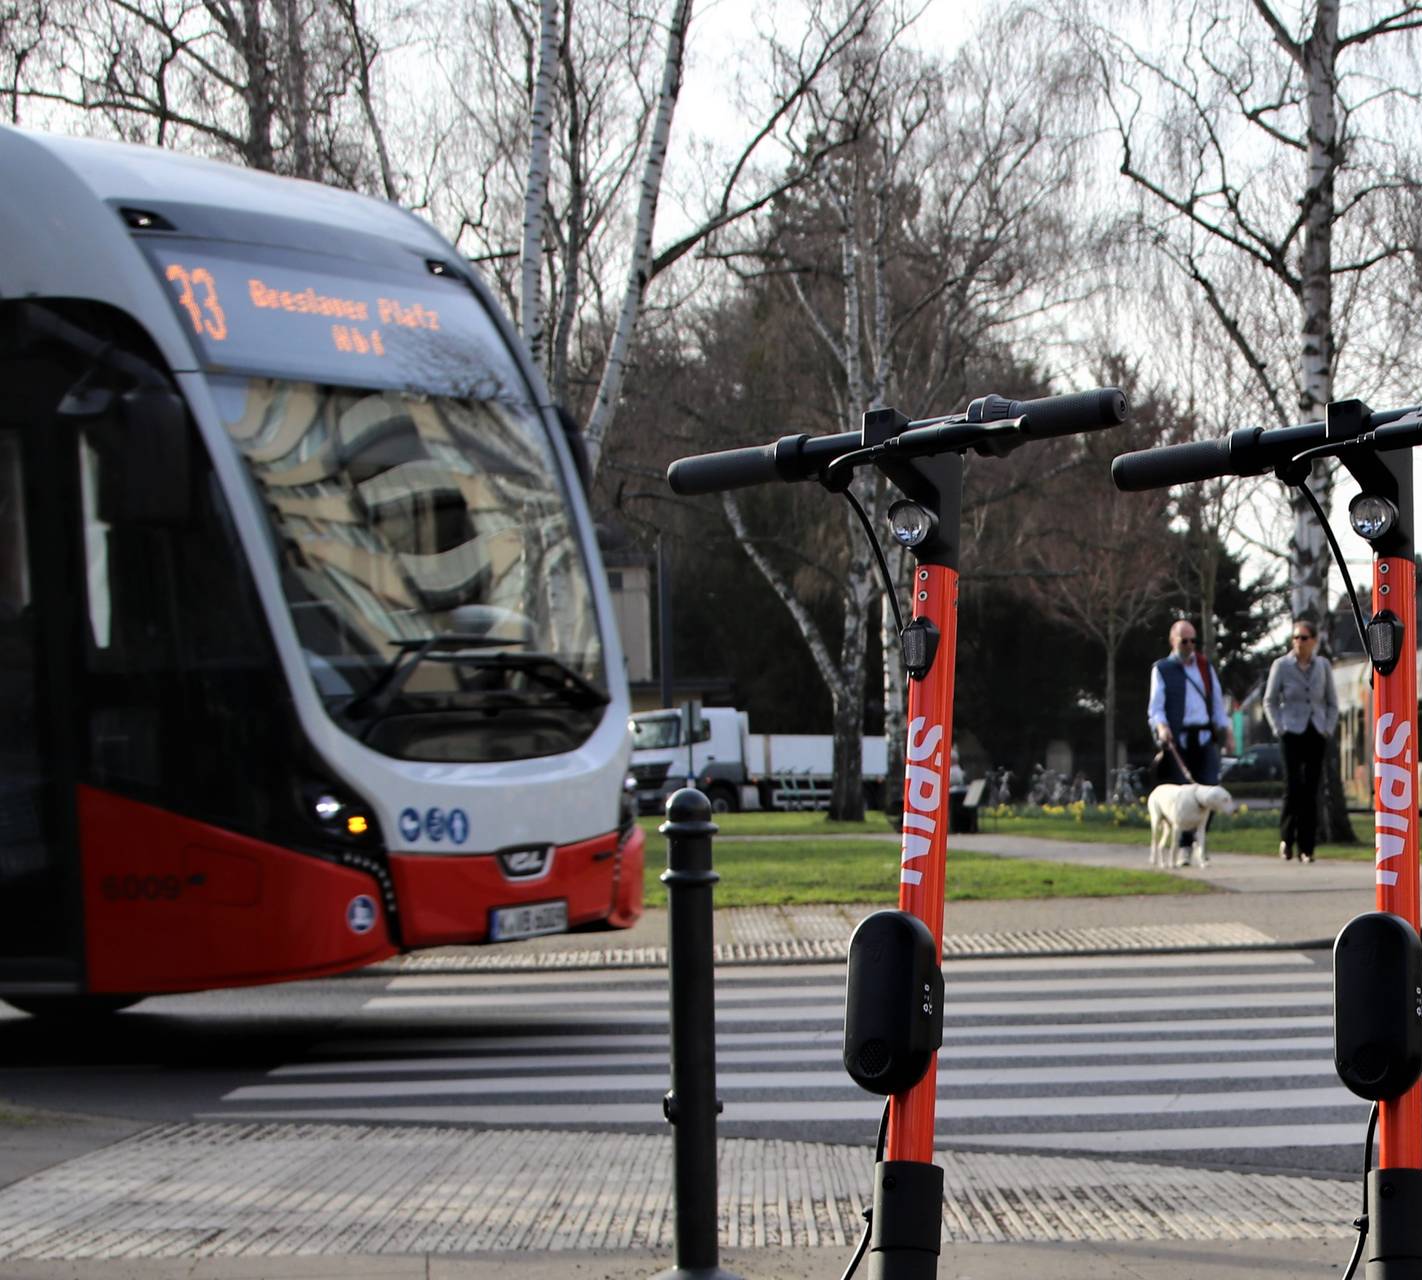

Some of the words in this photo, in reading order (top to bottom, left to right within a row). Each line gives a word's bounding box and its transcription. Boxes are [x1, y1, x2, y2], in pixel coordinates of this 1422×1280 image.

[249, 278, 368, 321] Breslauer
[377, 297, 440, 331] Platz
[331, 324, 385, 357] Hbf
